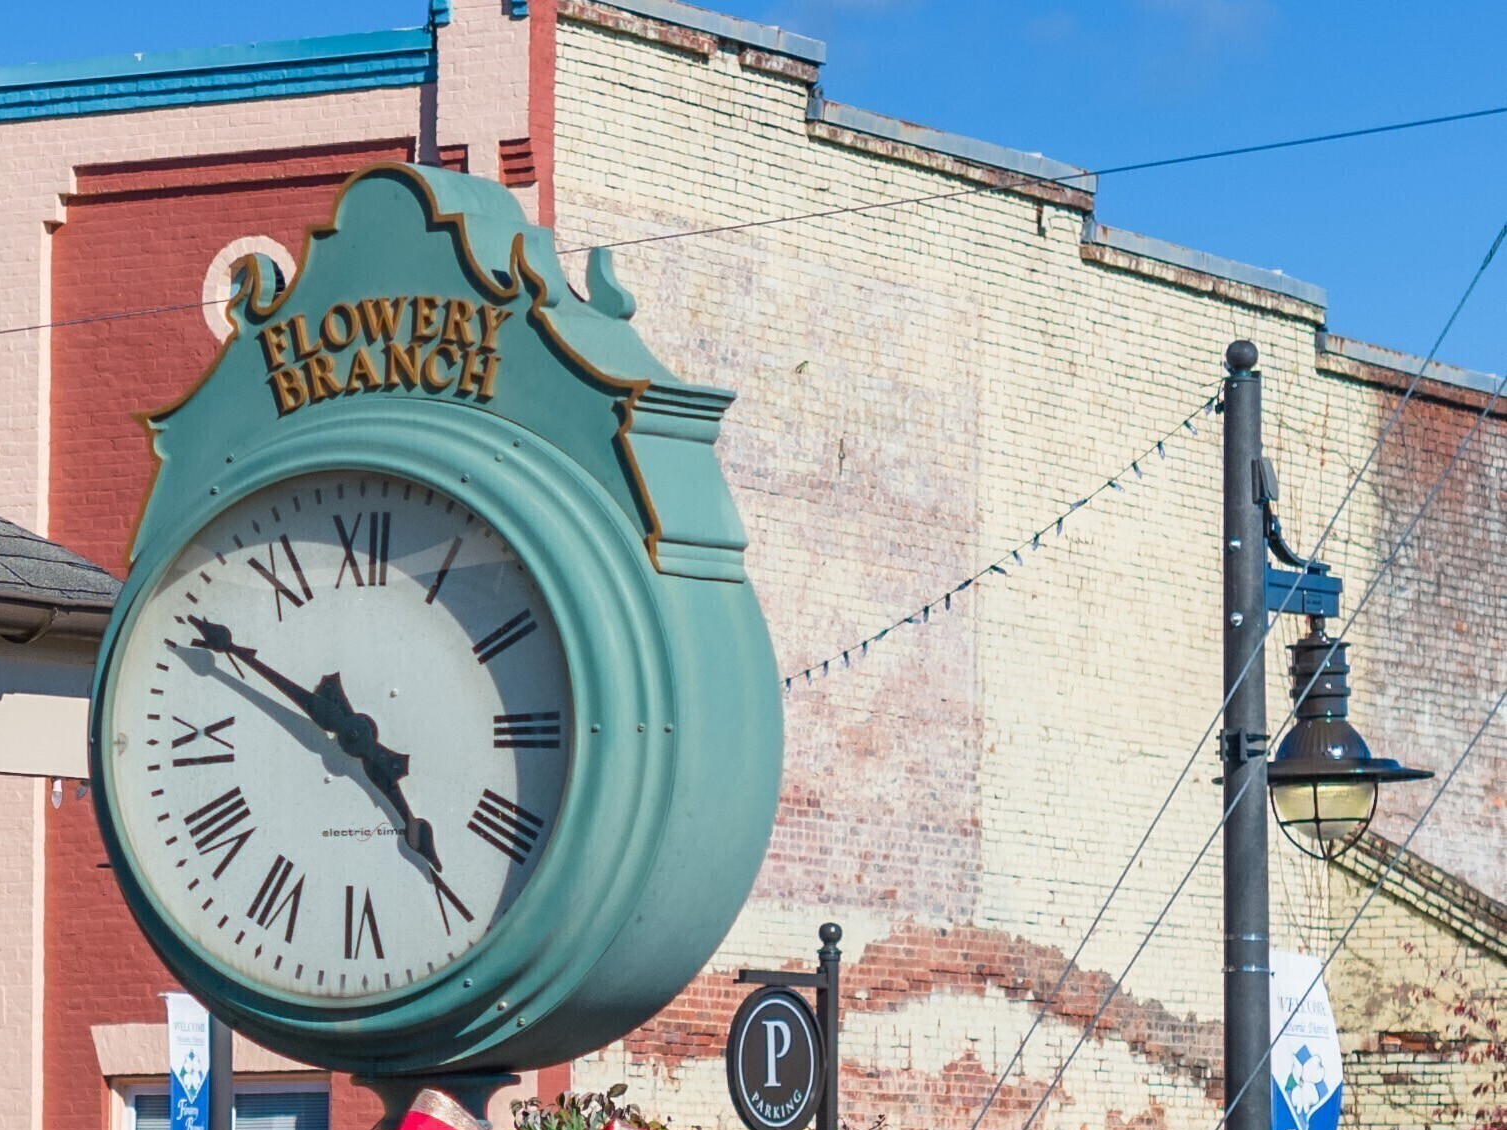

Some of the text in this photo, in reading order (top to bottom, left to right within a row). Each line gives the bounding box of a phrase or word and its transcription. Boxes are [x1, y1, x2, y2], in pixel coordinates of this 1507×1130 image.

[259, 295, 513, 369] FLOWERY
[270, 341, 501, 413] BRANCH
[247, 533, 314, 622] XI
[332, 512, 391, 589] XII
[472, 608, 538, 666] II
[494, 711, 560, 749] III
[322, 828, 371, 837] electric
[761, 1019, 792, 1088] P
[751, 1089, 803, 1120] PARKING
